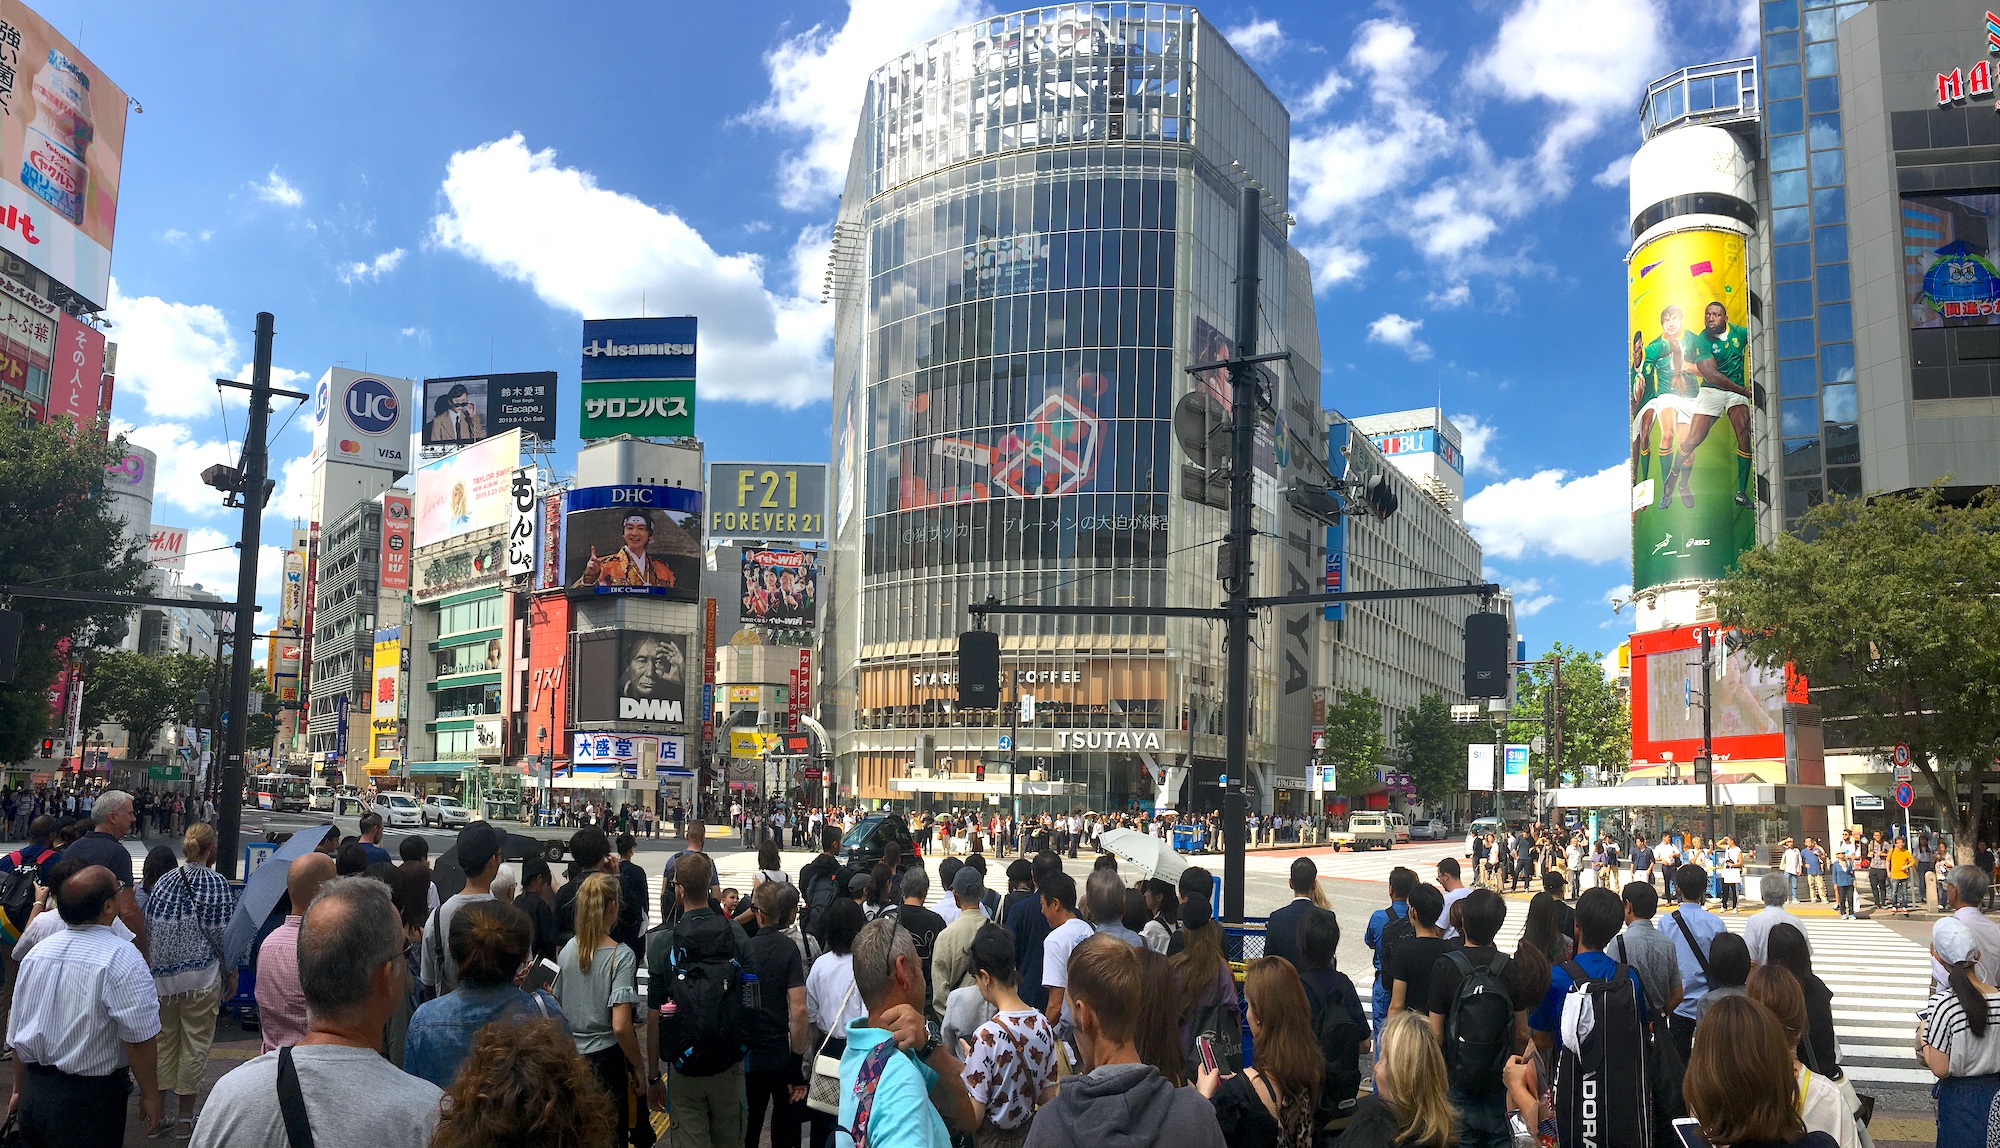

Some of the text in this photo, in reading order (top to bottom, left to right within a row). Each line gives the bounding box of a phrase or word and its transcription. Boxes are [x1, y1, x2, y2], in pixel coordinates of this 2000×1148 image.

[1936, 60, 2000, 106] MA
[45, 141, 71, 165] Yakult
[38, 157, 73, 190] ヤクルト
[583, 339, 695, 358] Hisamitsu
[501, 386, 545, 398] 鈴木愛理
[350, 390, 395, 421] UC
[501, 404, 543, 414] 「Escape」
[584, 397, 688, 419] サロンパス
[378, 448, 401, 460] VISA
[473, 466, 515, 485] TAYLOR SWIFT
[498, 484, 510, 493] OUT
[611, 488, 653, 503] DHC
[737, 470, 797, 508] F21
[510, 470, 534, 569] もんじゃ
[713, 511, 821, 532] FOREVER 21
[149, 531, 184, 554] H&M
[801, 655, 809, 699] カラオケ
[1018, 670, 1081, 684] COFFEE
[620, 697, 683, 722] DMM
[578, 738, 678, 760] 大盛堂店
[1057, 731, 1160, 750] TSUTAYA
